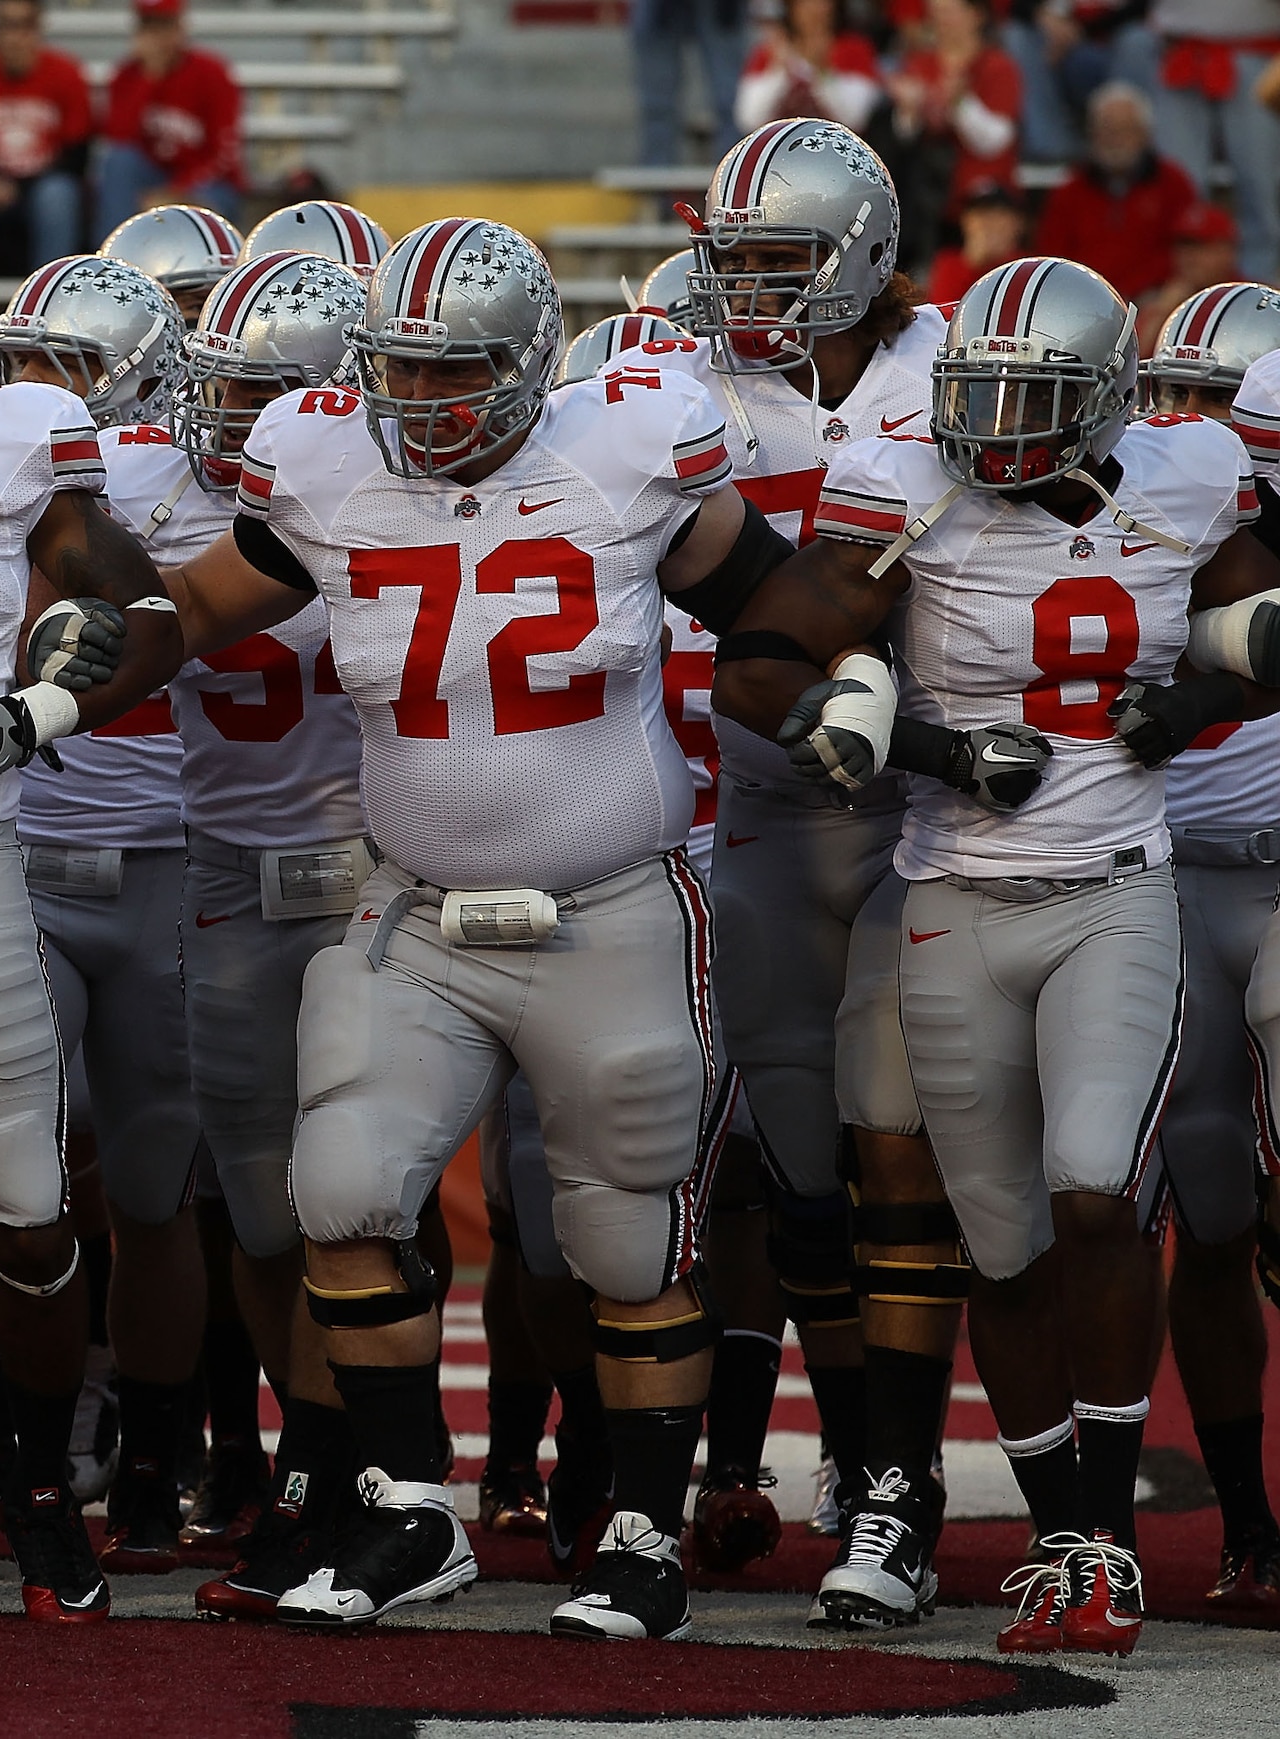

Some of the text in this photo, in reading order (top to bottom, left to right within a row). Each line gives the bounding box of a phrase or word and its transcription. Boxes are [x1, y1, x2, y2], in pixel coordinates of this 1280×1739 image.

[93, 364, 126, 396] Ridell
[347, 536, 608, 740] 72
[1021, 575, 1140, 741] 8
